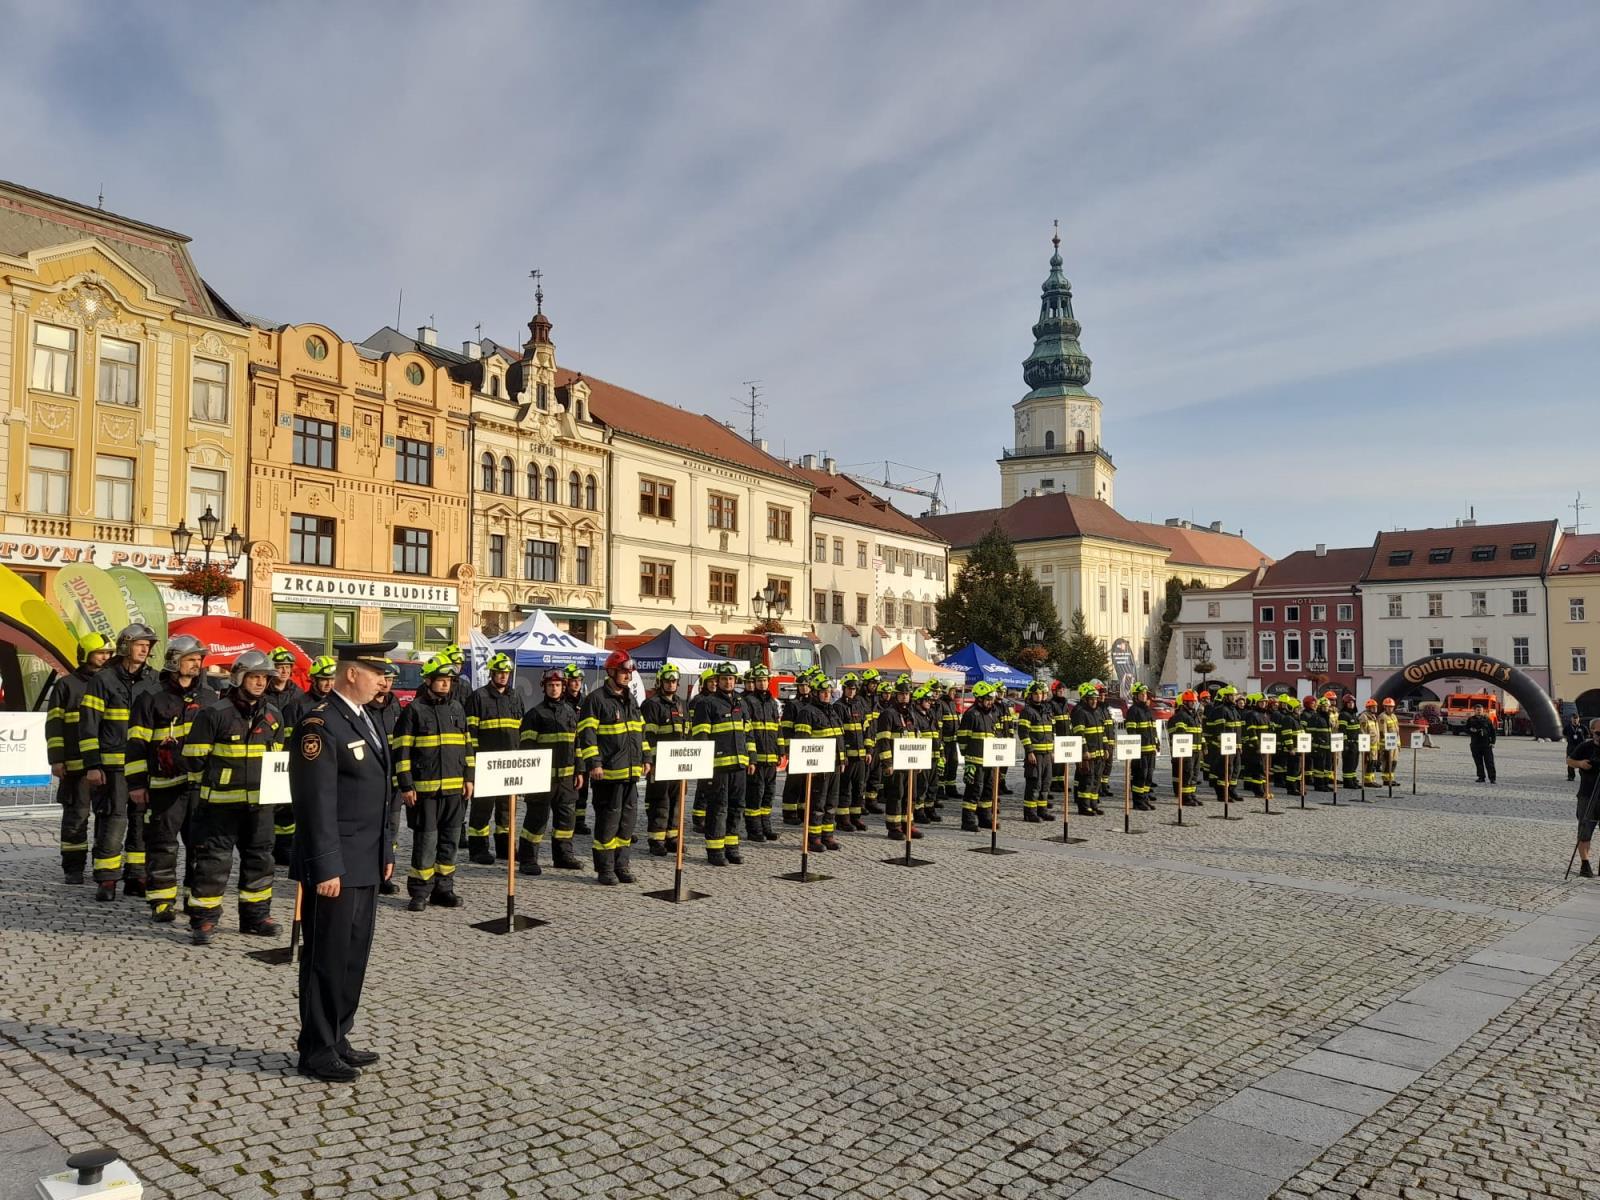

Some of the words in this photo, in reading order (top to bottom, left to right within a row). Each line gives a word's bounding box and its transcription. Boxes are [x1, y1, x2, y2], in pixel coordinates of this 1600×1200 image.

[683, 459, 712, 472] MUZEUM
[284, 577, 375, 596] ZRCADLOVÉ
[383, 580, 449, 601] BLUDIŠTĚ
[532, 631, 578, 648] 211
[637, 660, 664, 670] SERVIS
[1404, 657, 1500, 684] Continental
[487, 757, 542, 770] STŘEDOČESKÝ
[677, 763, 693, 773] KRAJ
[504, 776, 523, 787] KRAJ
